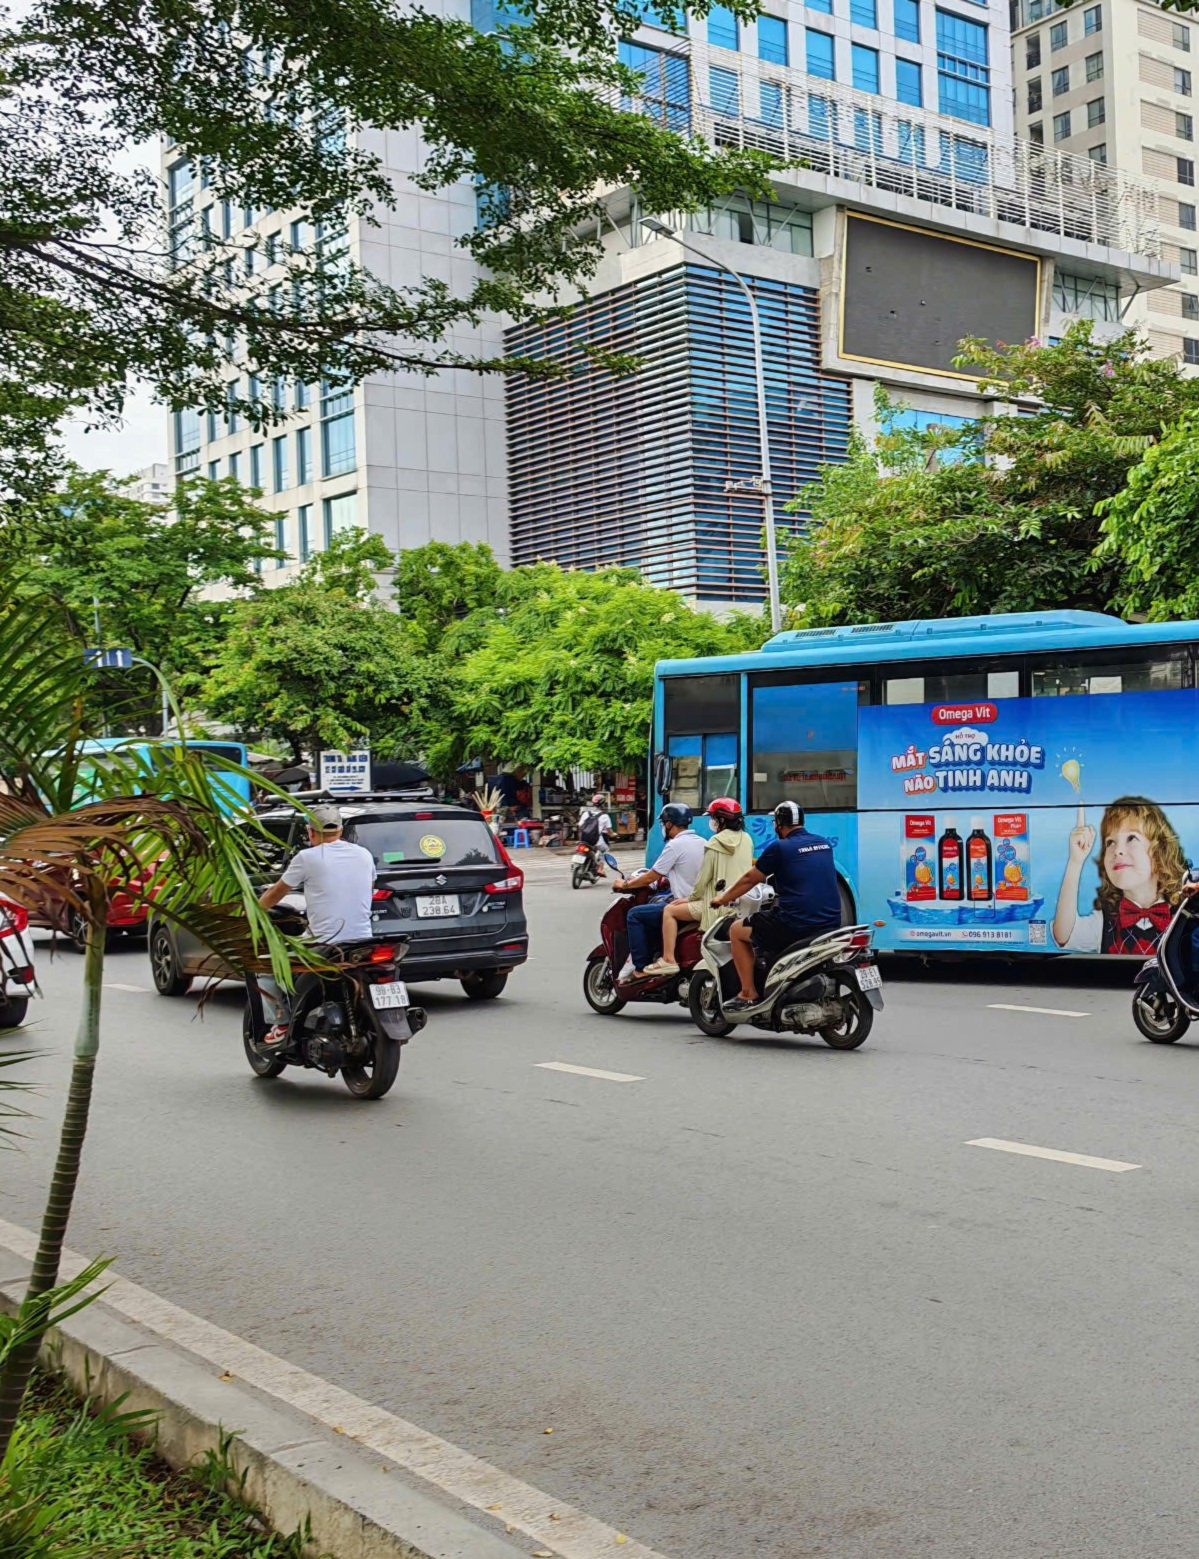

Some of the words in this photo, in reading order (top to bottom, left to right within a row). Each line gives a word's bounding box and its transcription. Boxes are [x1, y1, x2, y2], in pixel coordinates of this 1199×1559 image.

[938, 708, 973, 721] Omega
[975, 706, 991, 718] Vit
[892, 746, 926, 771] MẮT
[929, 738, 983, 766] SÁNG
[986, 739, 1044, 766] KHỎE
[903, 774, 936, 794] NÃO
[935, 769, 982, 790] TINH
[986, 769, 1030, 789] ANH
